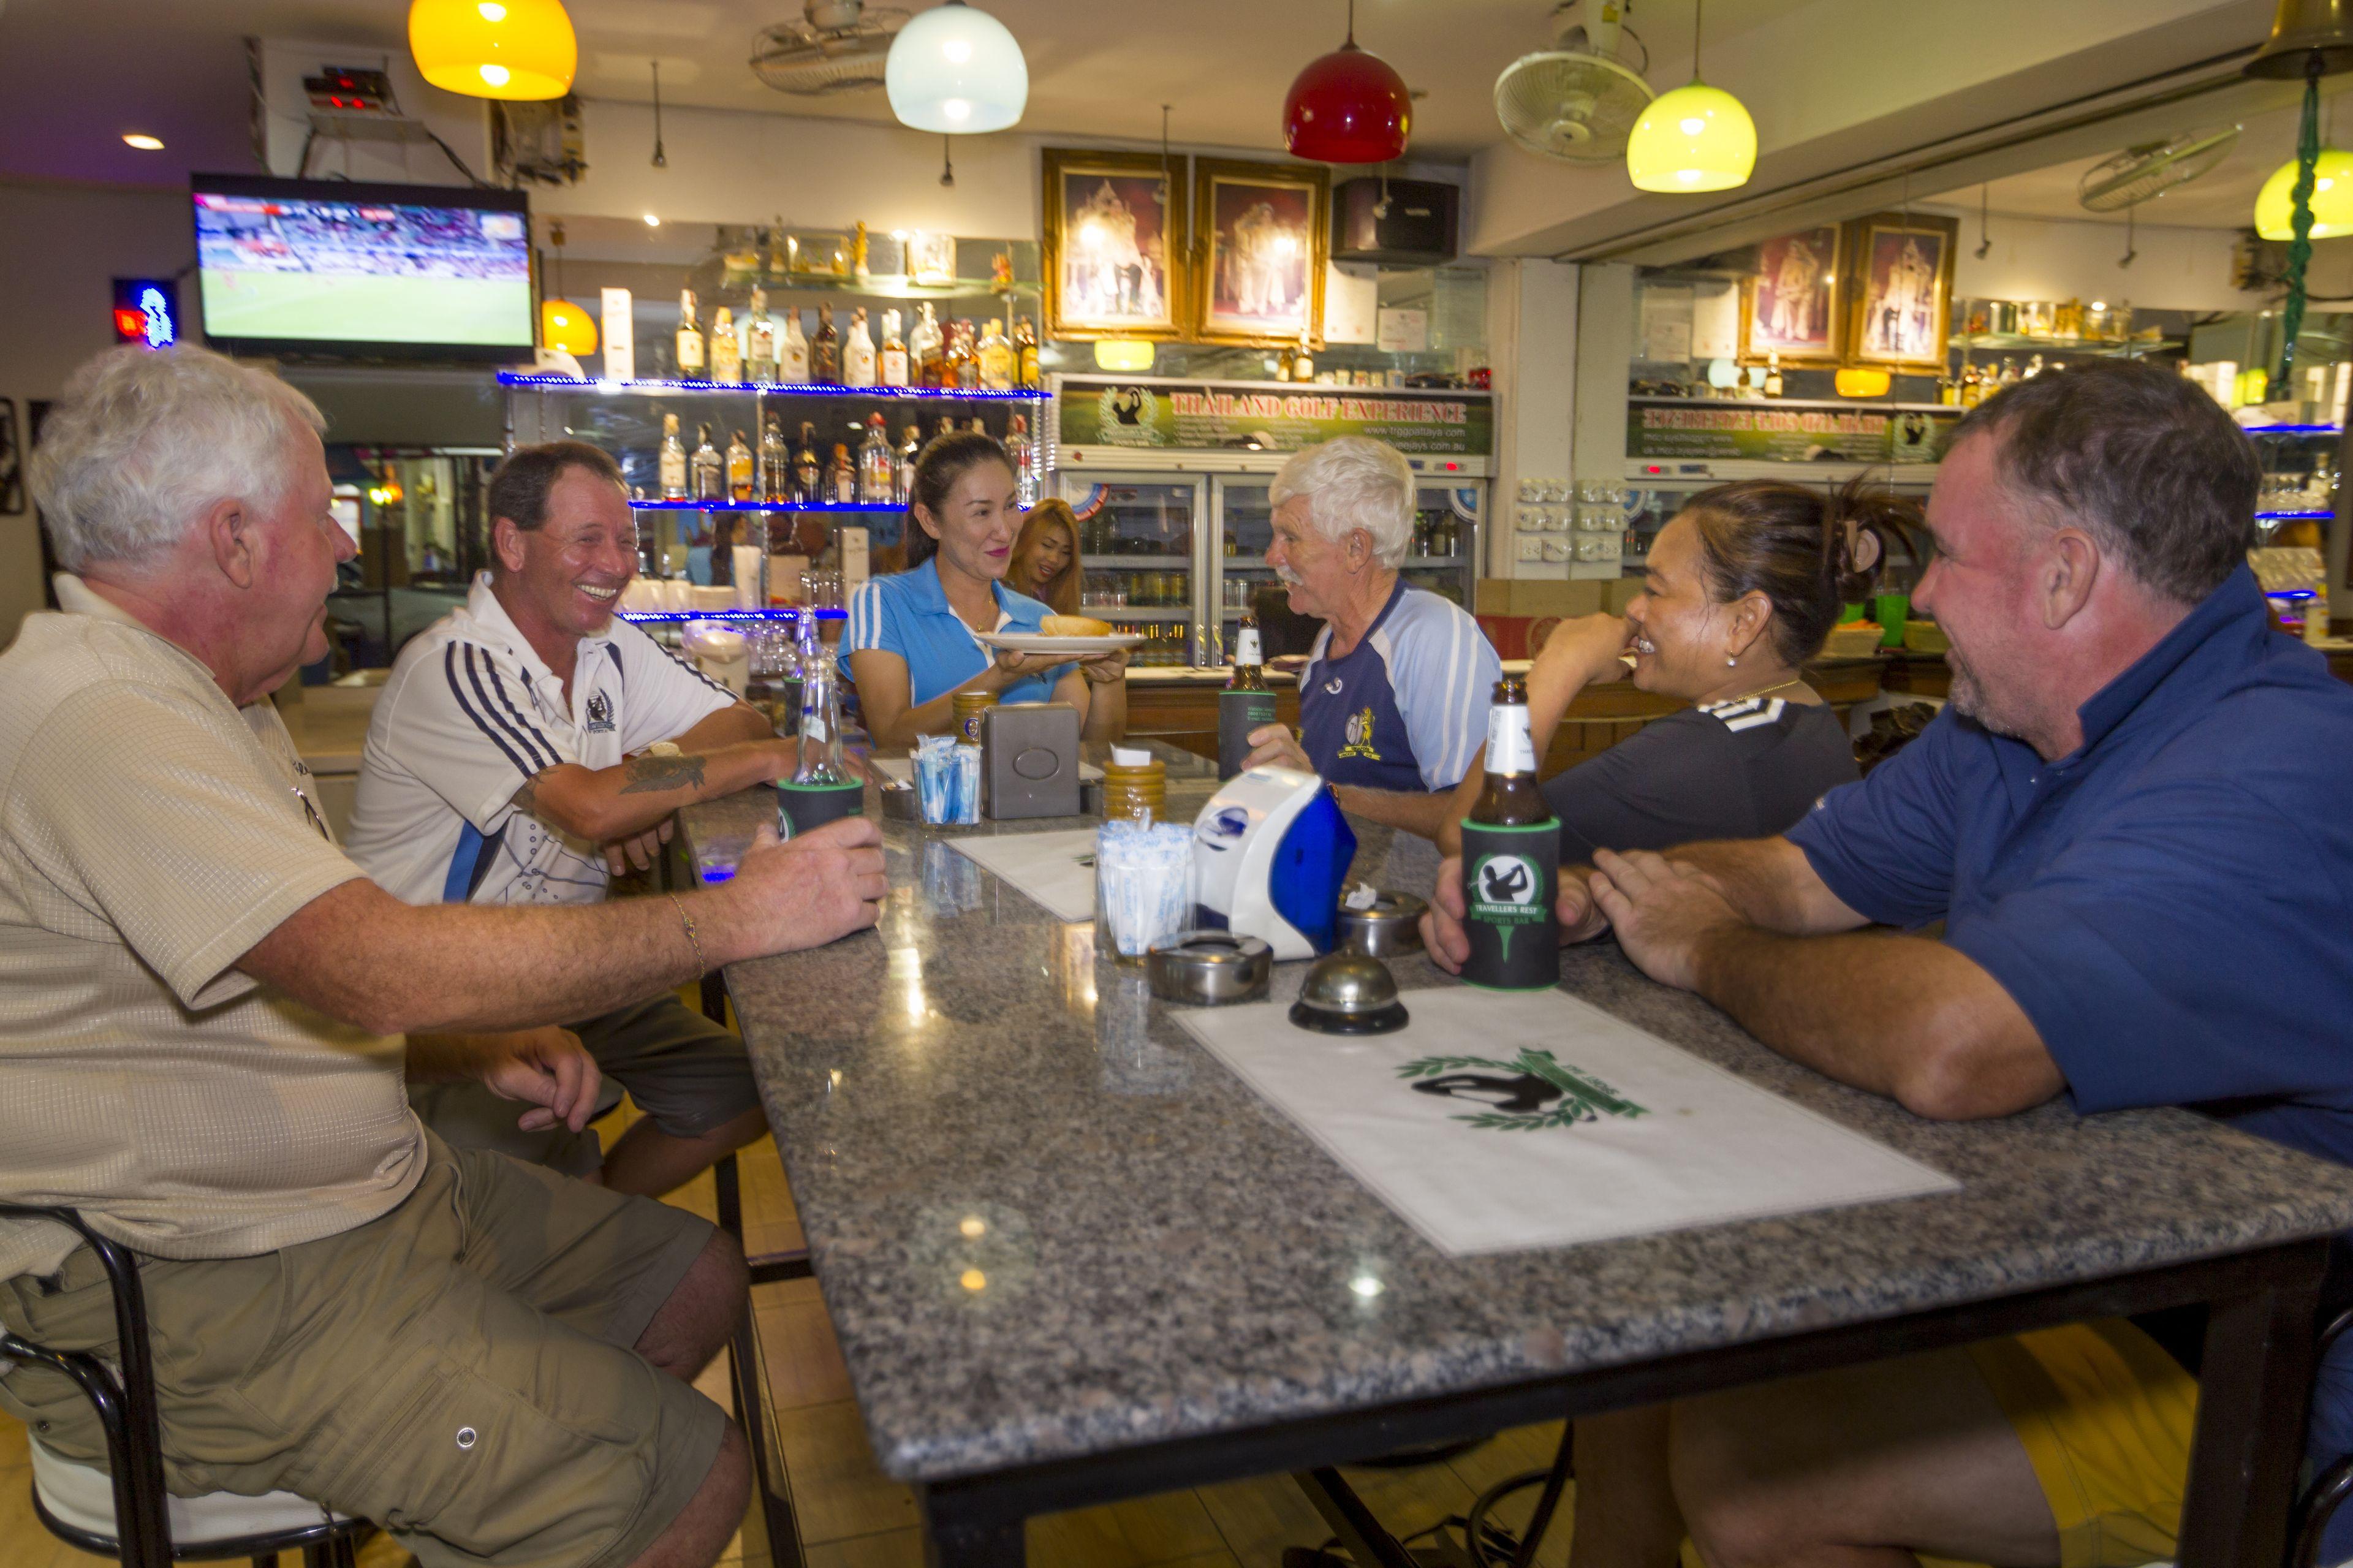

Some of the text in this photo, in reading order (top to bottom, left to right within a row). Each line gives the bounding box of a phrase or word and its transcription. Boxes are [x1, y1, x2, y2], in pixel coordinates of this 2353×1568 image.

[1169, 392, 1467, 424] THAILAND GOLF EXPERIENCE
